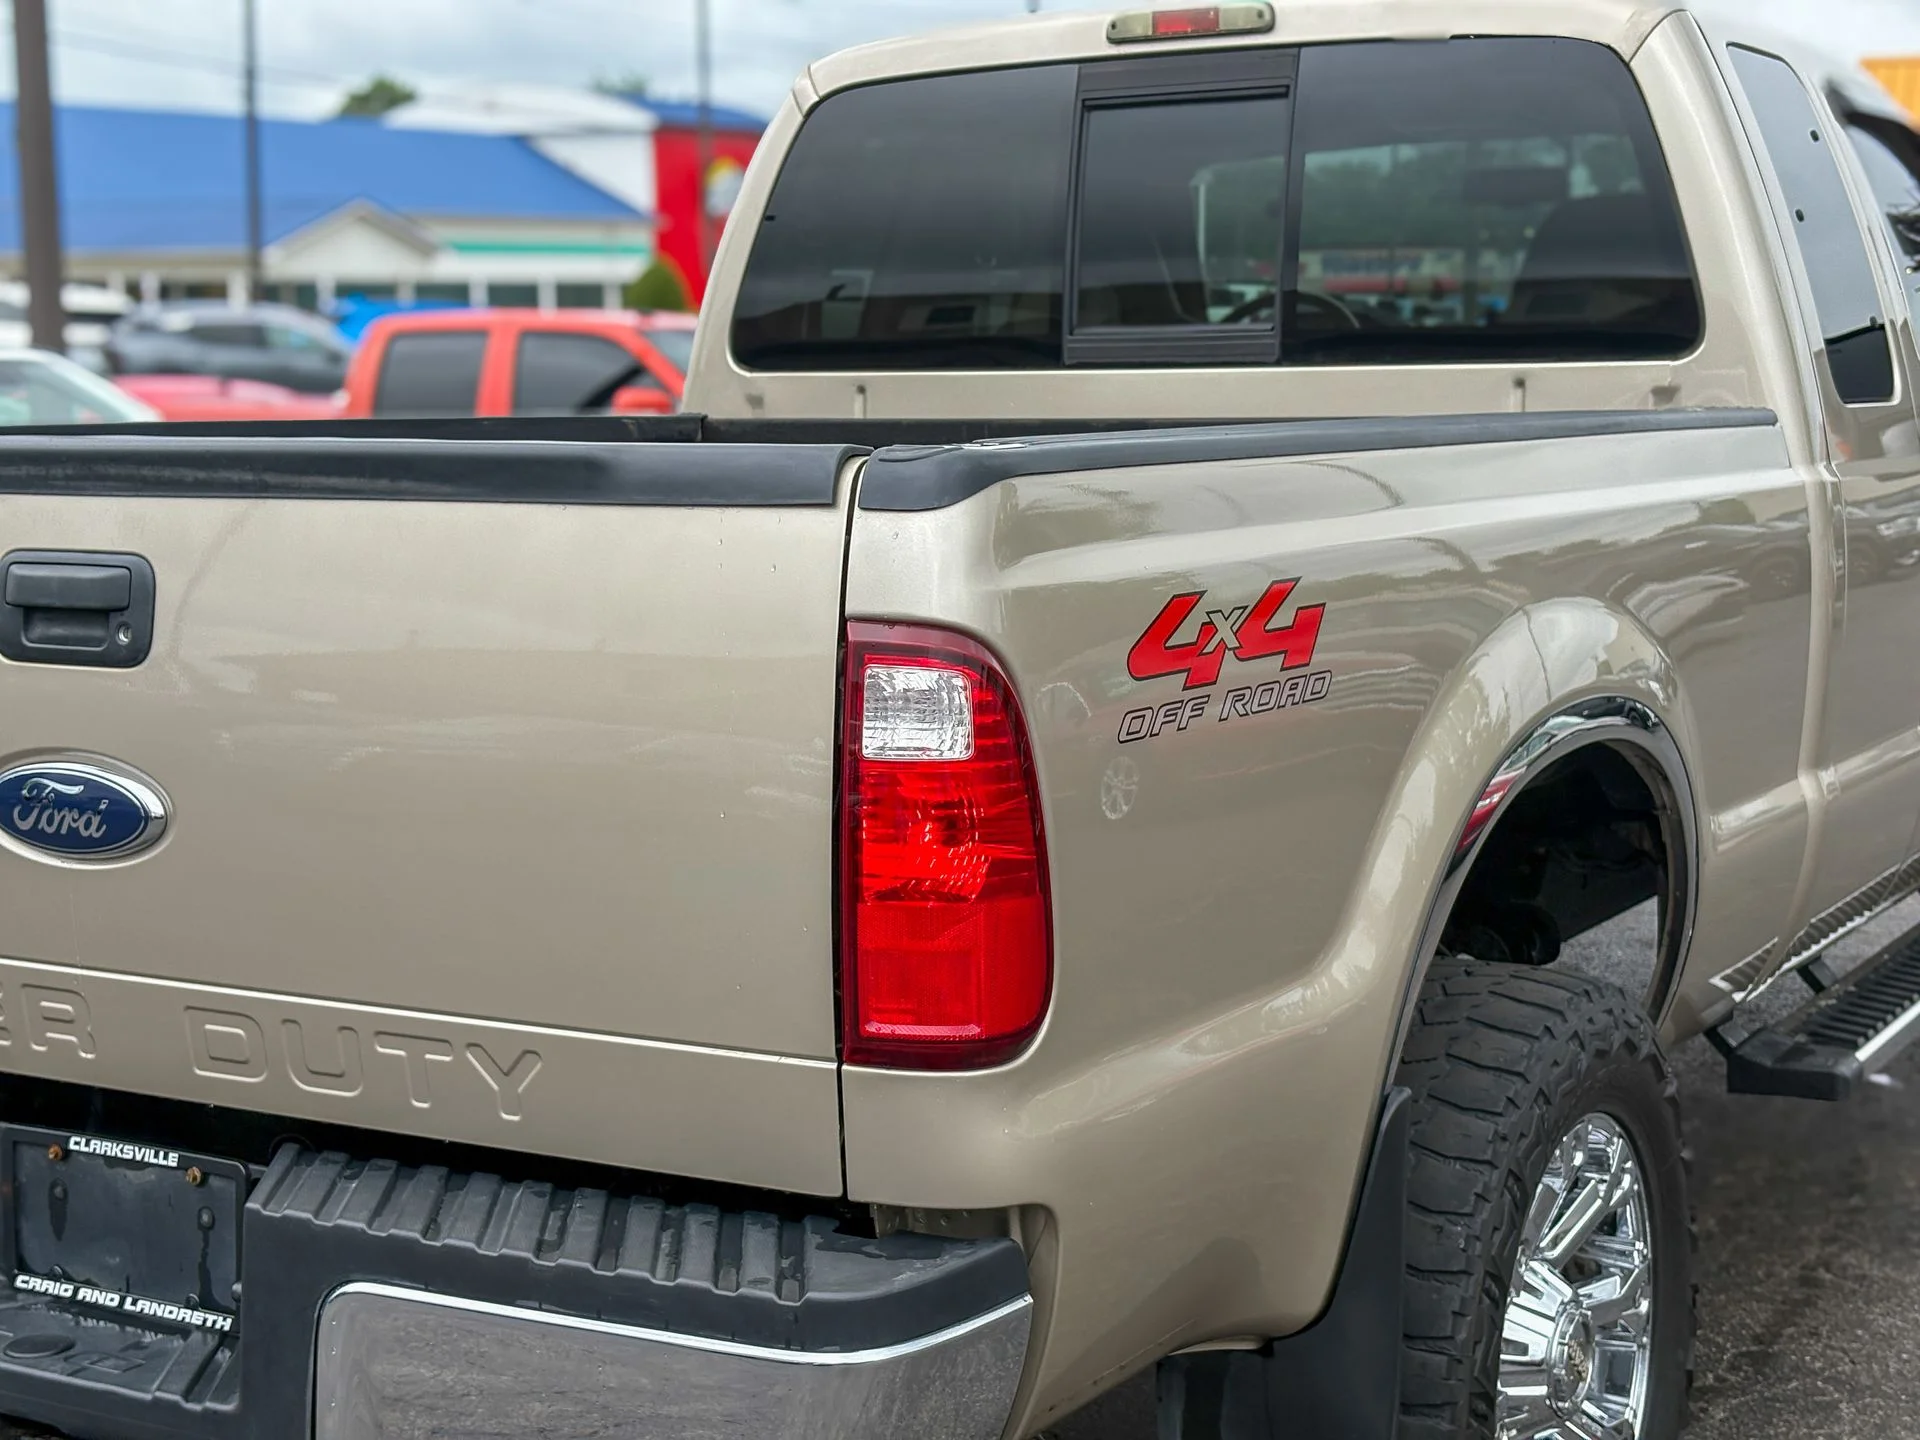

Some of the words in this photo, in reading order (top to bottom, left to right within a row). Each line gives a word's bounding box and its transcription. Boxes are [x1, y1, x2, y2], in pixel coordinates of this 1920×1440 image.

[1117, 694, 1210, 744] OFF
[1218, 669, 1332, 722] ROAD
[13, 777, 109, 839] Ford
[0, 982, 97, 1060] R
[183, 1005, 544, 1121] DUTY
[69, 1136, 179, 1167] CLARKSVILLE
[77, 1287, 120, 1308] AND
[123, 1296, 232, 1332] LANDRETH
